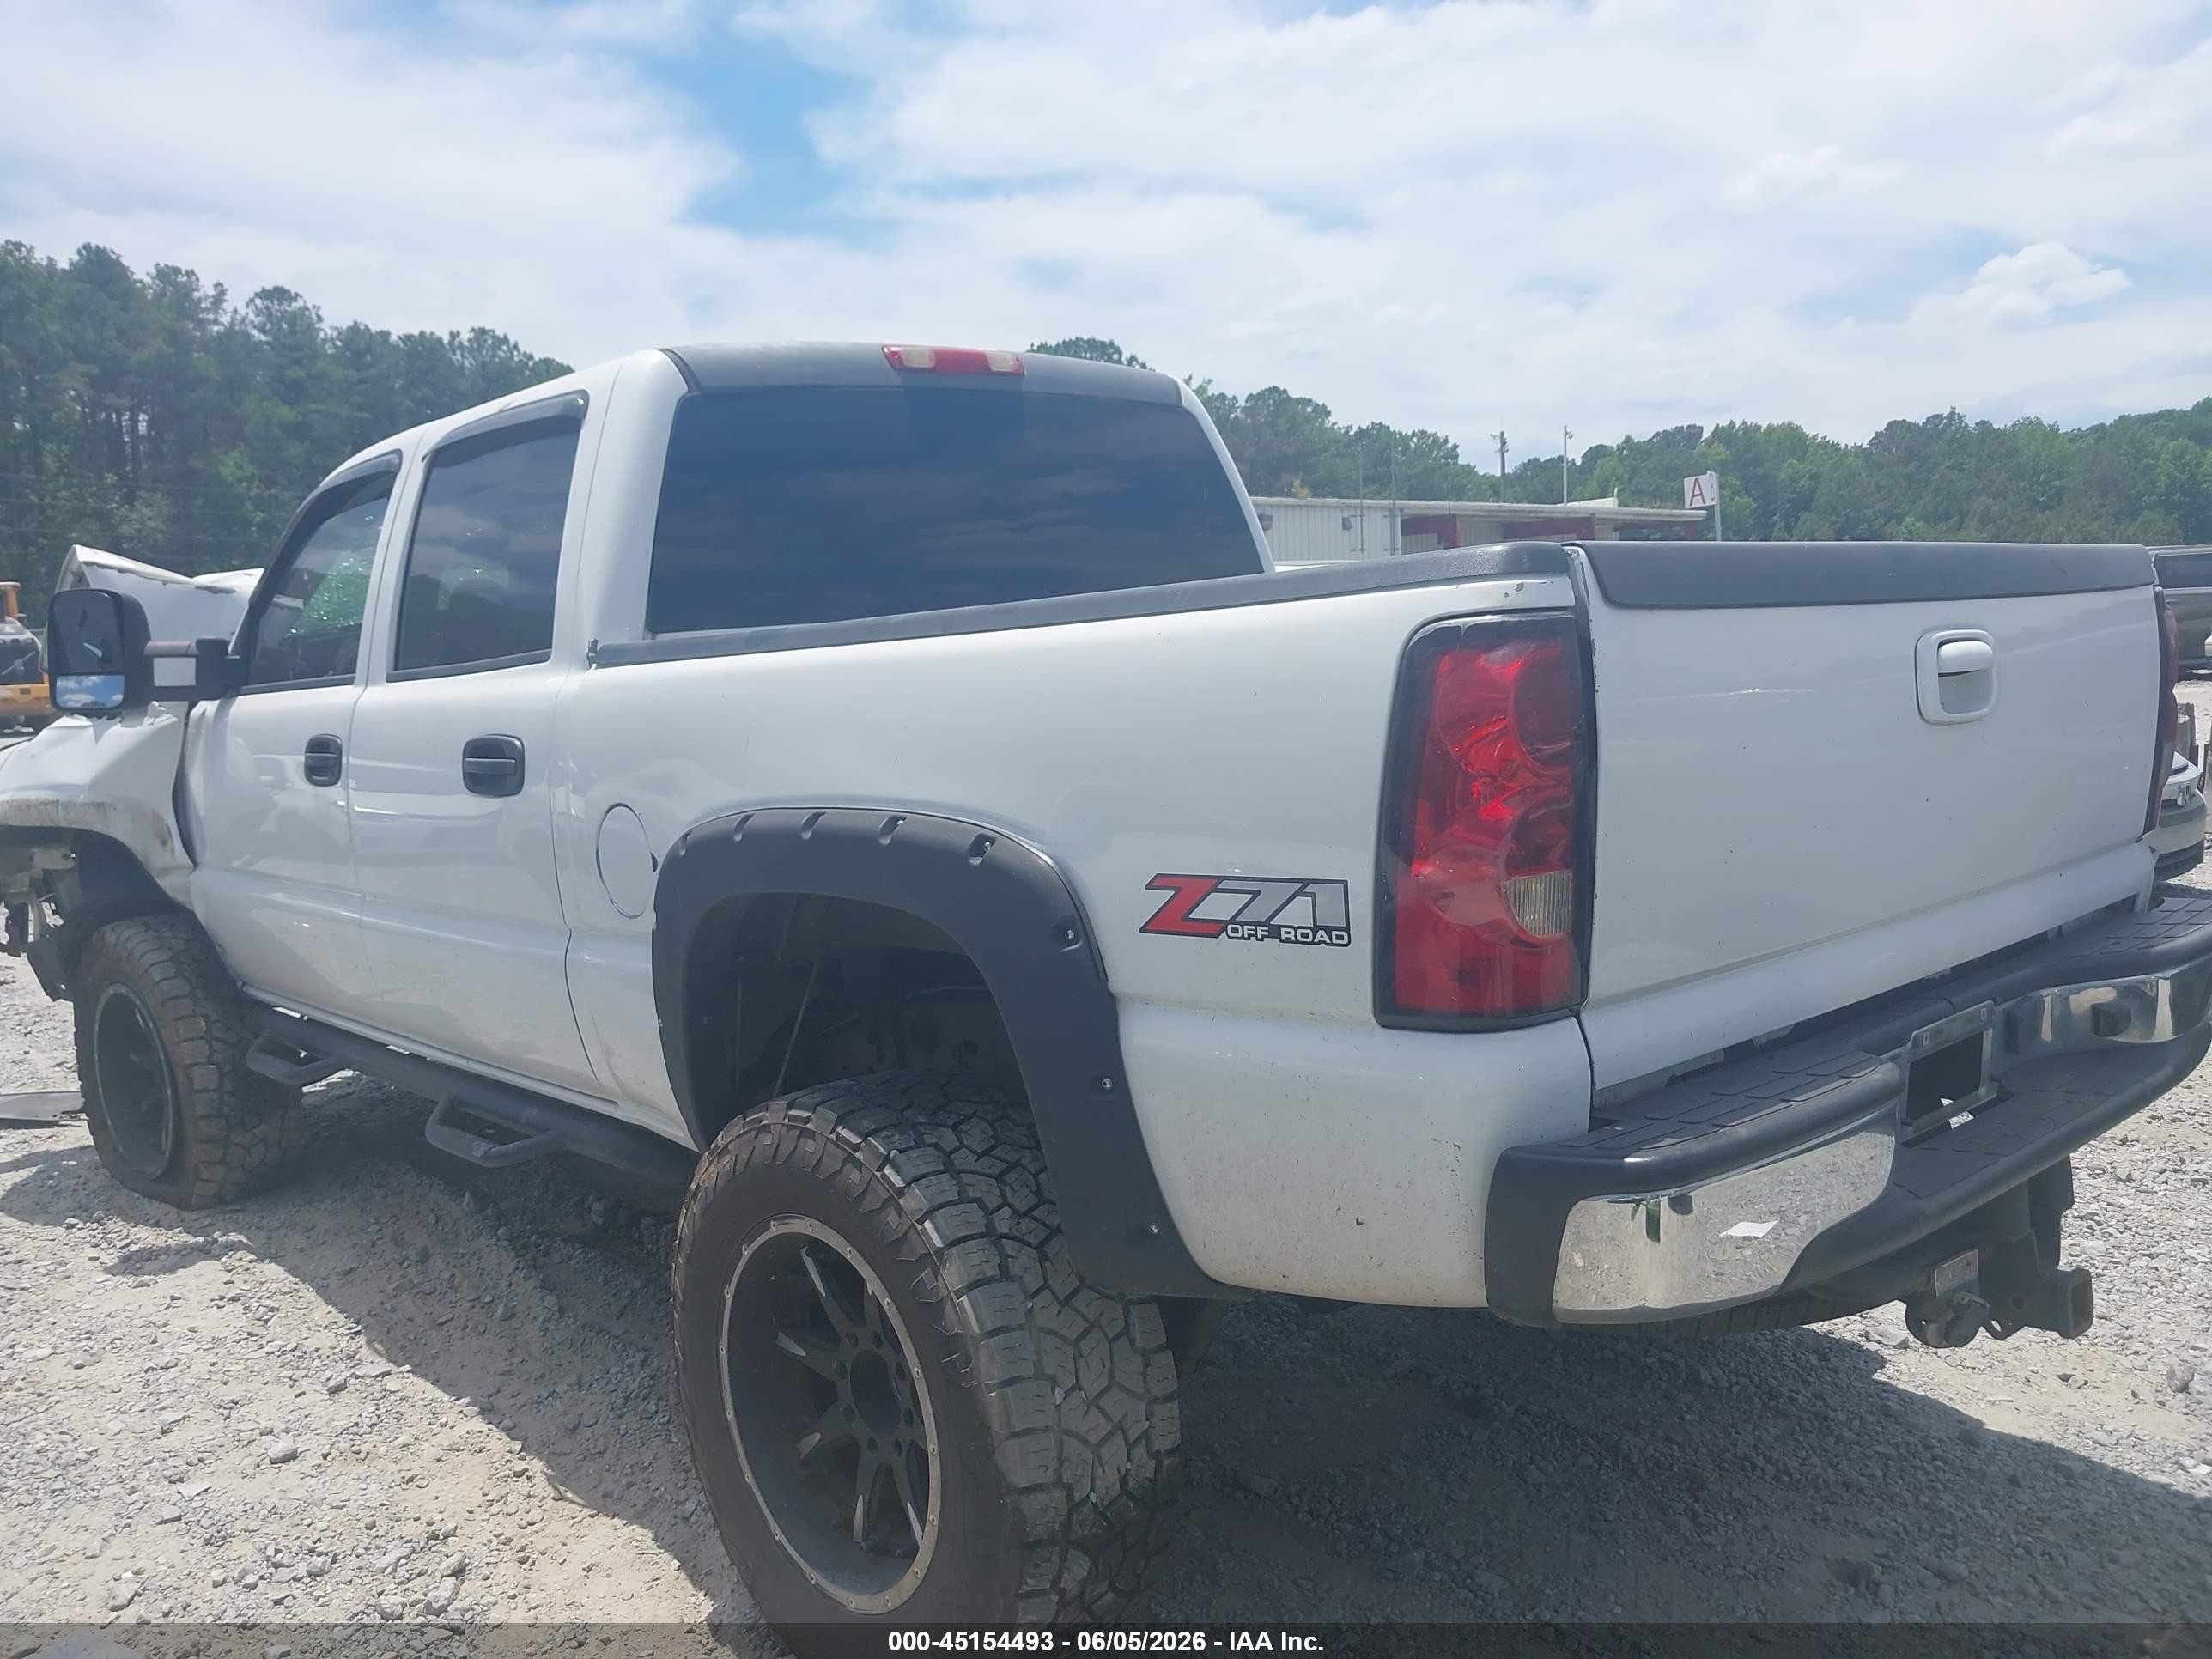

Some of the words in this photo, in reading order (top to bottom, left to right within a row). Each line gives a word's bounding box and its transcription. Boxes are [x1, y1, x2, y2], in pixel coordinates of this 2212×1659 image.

[1689, 477, 1706, 507] A
[1139, 873, 1351, 939] Z71
[1226, 923, 1269, 939] OFF
[1279, 927, 1349, 945] ROAD
